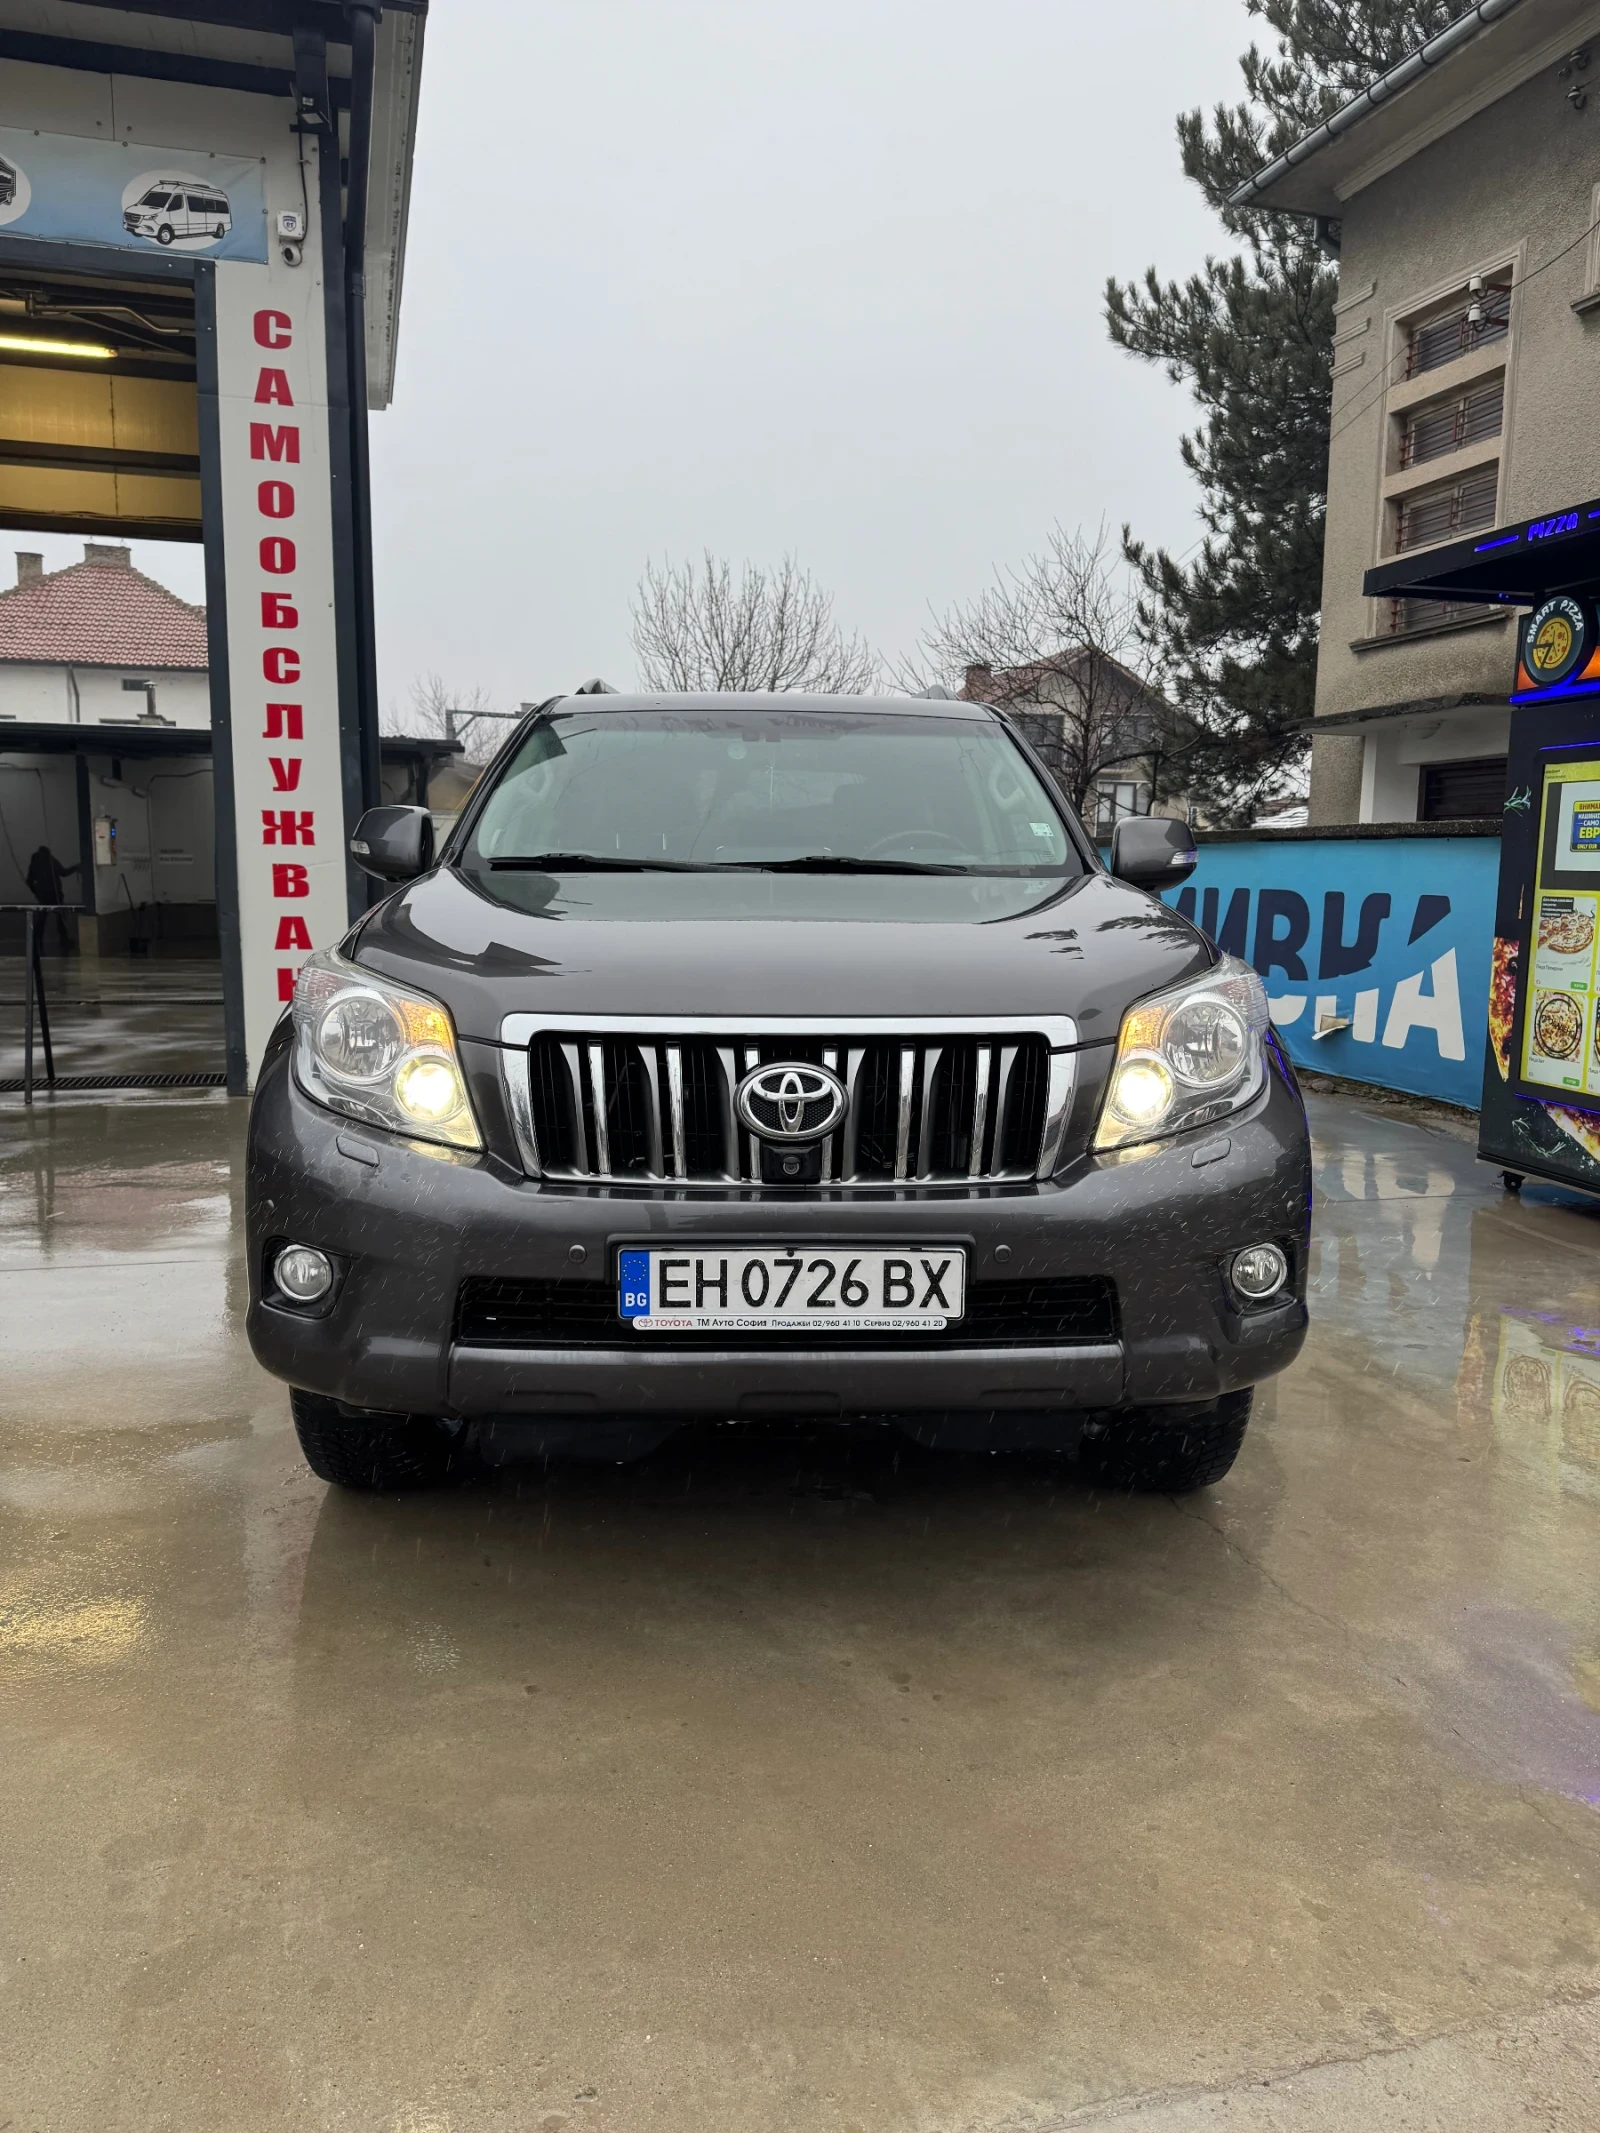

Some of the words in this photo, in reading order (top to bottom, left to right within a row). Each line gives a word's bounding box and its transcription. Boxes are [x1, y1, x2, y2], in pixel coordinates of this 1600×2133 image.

[1527, 512, 1578, 541] PIZZA
[1527, 600, 1557, 643] SMART
[1560, 600, 1584, 631] PIZZA
[659, 1259, 728, 1308] EH
[741, 1259, 869, 1308] 0726
[883, 1259, 951, 1309] BX
[625, 1292, 647, 1307] BG
[655, 1319, 693, 1327] TOYOTA
[813, 1319, 840, 1328] 02/960
[853, 1319, 861, 1327] 10
[892, 1319, 920, 1328] 02/960
[933, 1319, 943, 1327] 20
